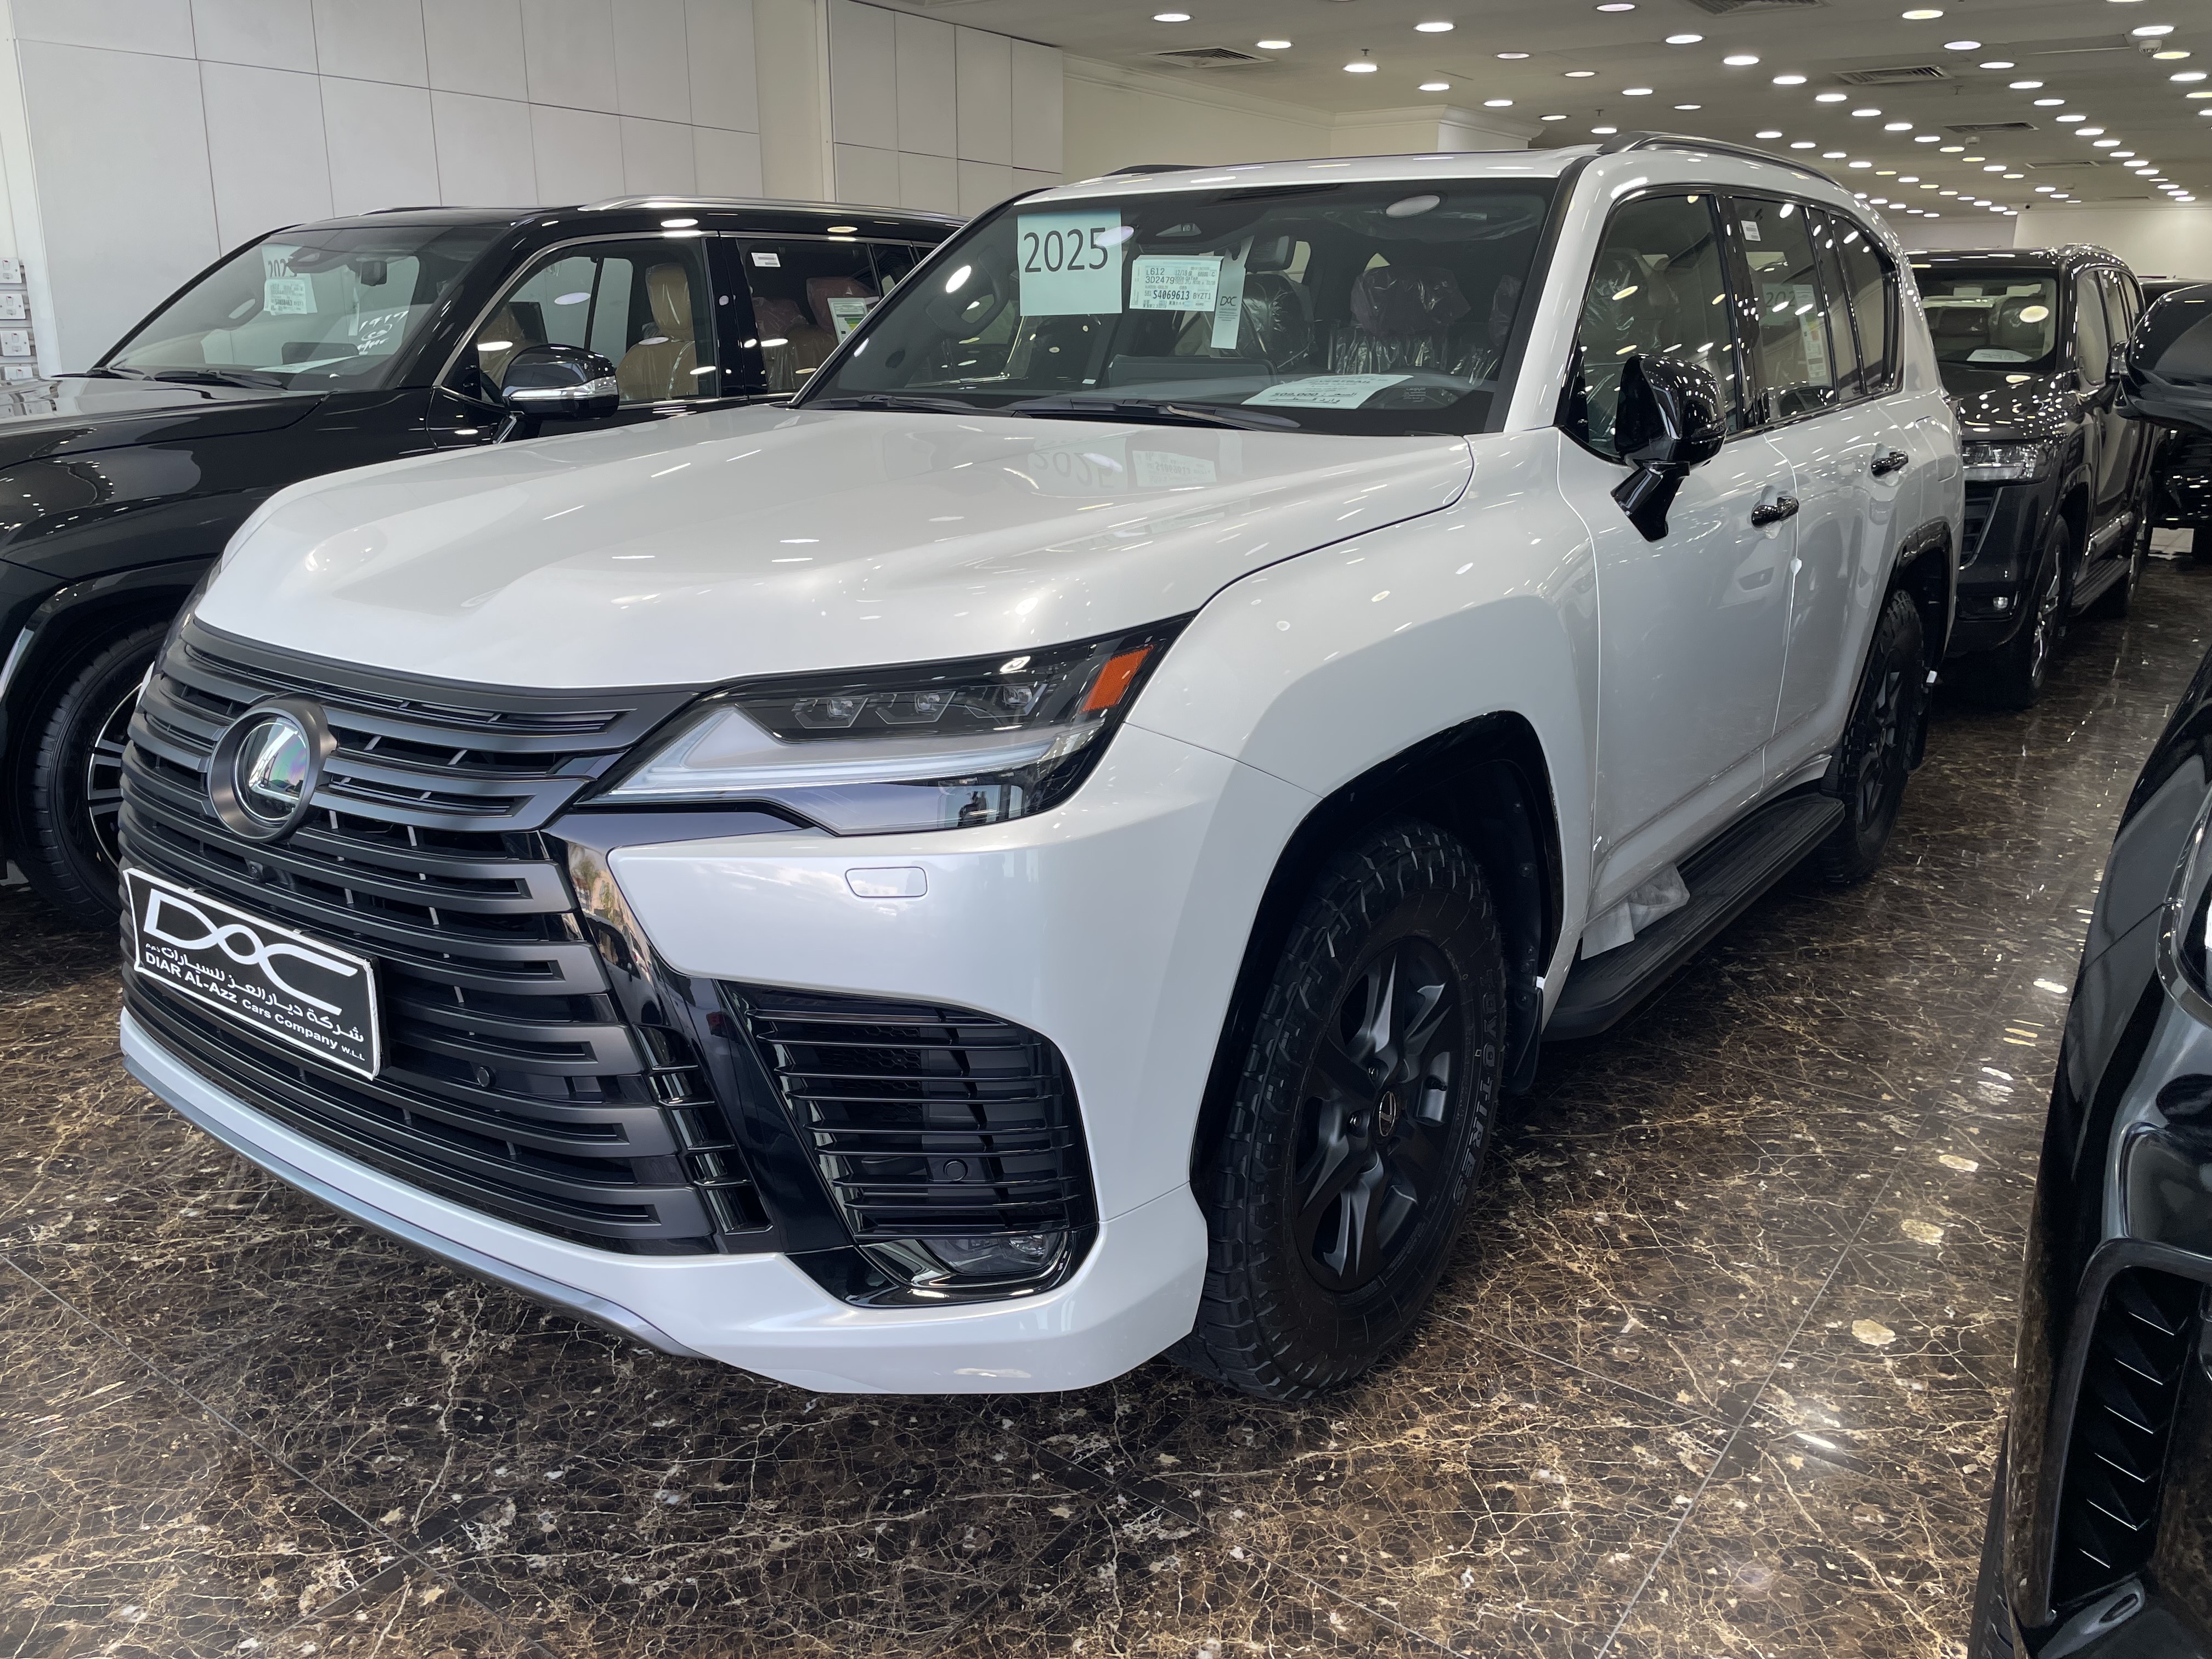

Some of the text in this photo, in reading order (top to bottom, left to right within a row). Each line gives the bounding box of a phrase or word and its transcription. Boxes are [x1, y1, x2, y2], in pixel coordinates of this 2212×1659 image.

[1024, 227, 1108, 273] 2025
[1146, 276, 1175, 284] 3D2479
[1153, 290, 1190, 300] S4069613
[161, 946, 225, 981] للسيارات
[145, 951, 182, 979] DIAR
[241, 998, 272, 1019] Cars
[274, 1013, 338, 1050] Company
[228, 974, 266, 1000] العز
[265, 993, 303, 1018] ديار
[306, 1008, 364, 1042] شركة
[1453, 1076, 1494, 1206] TIRES
